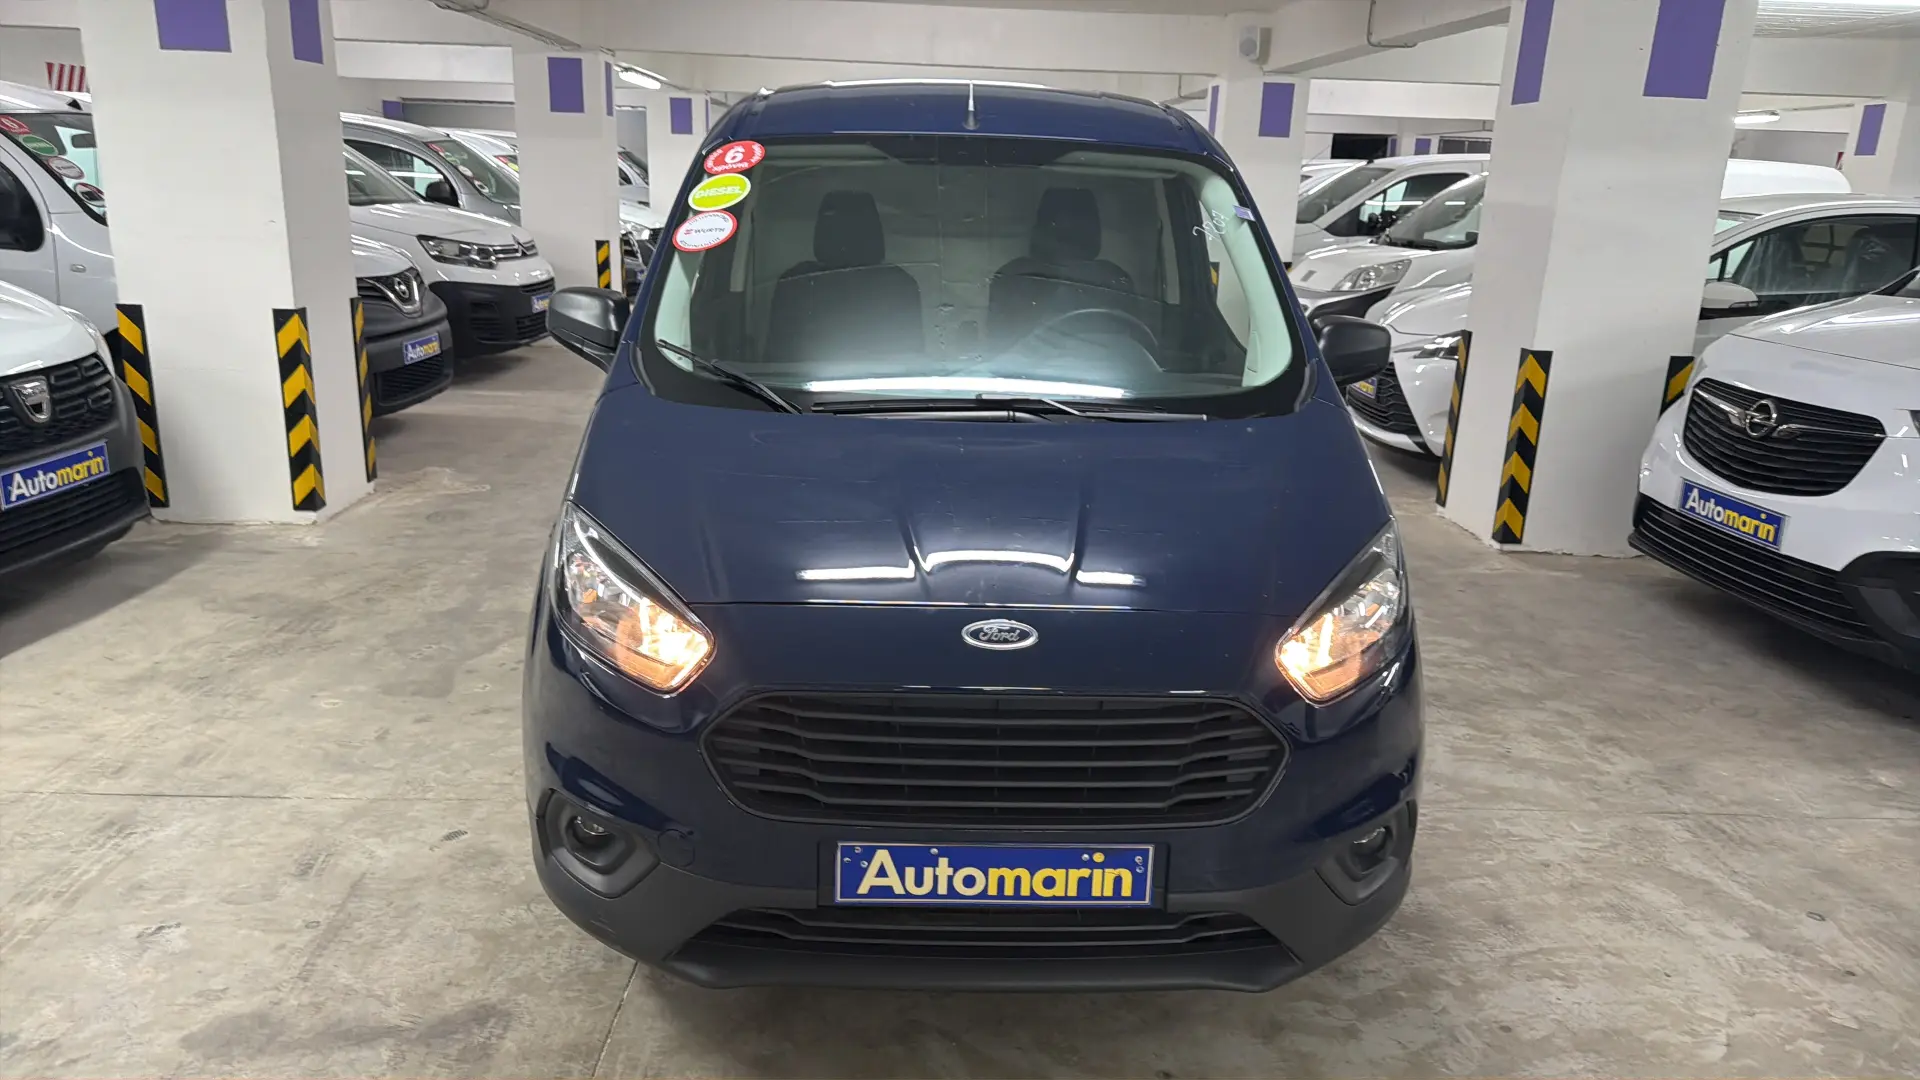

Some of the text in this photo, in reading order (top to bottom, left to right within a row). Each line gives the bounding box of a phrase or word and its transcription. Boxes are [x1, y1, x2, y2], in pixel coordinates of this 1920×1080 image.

[724, 145, 745, 163] 6
[695, 186, 743, 198] DIESEL
[10, 450, 105, 502] Automarin
[1684, 488, 1776, 542] Automarin
[979, 625, 1020, 641] Ford
[856, 849, 1133, 898] Automarin
